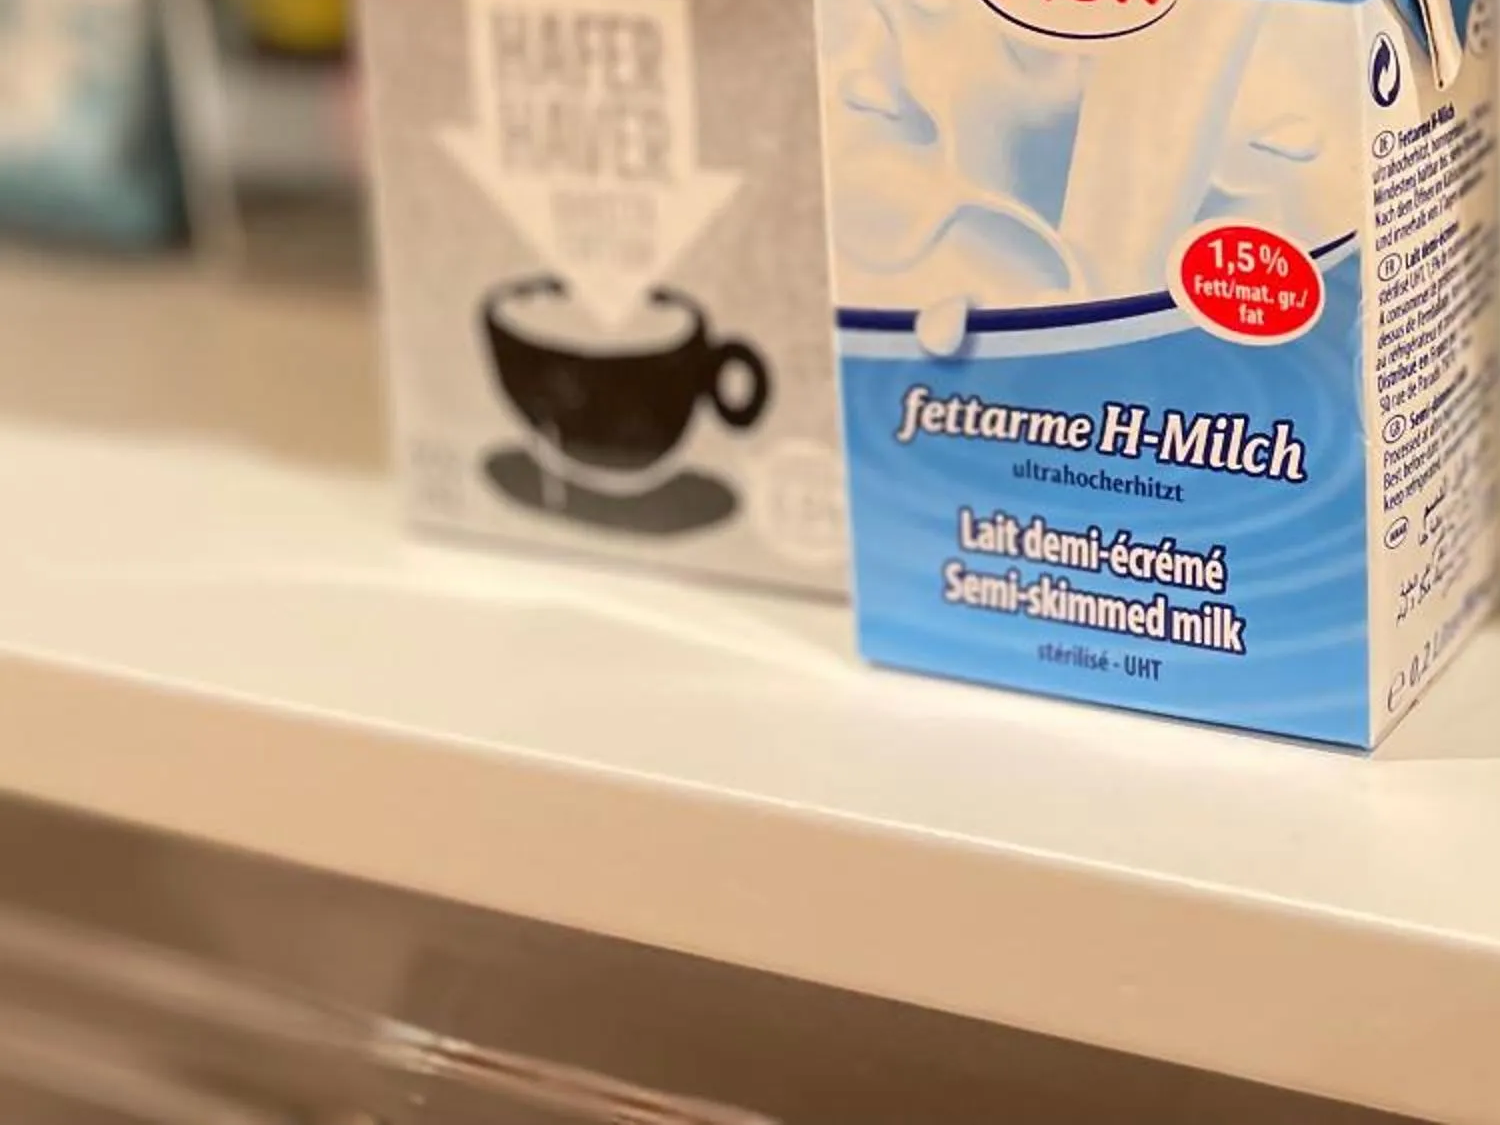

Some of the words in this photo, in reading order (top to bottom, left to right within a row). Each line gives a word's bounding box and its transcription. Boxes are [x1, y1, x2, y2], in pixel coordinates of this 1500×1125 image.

[489, 11, 664, 91] HAFER
[1193, 274, 1275, 305] Fett/mat.
[1238, 303, 1265, 326] fat
[897, 384, 1094, 449] fettarme
[1098, 400, 1308, 482] H-Milch
[1012, 458, 1185, 503] ultrahocherhitzt
[958, 507, 1020, 557] Lait
[1021, 514, 1228, 593] demi-écrémé
[942, 560, 1166, 642] Semi-skimmed
[1170, 602, 1248, 654] milk
[1037, 641, 1109, 671] stérilisé
[1124, 654, 1163, 681] UHT
